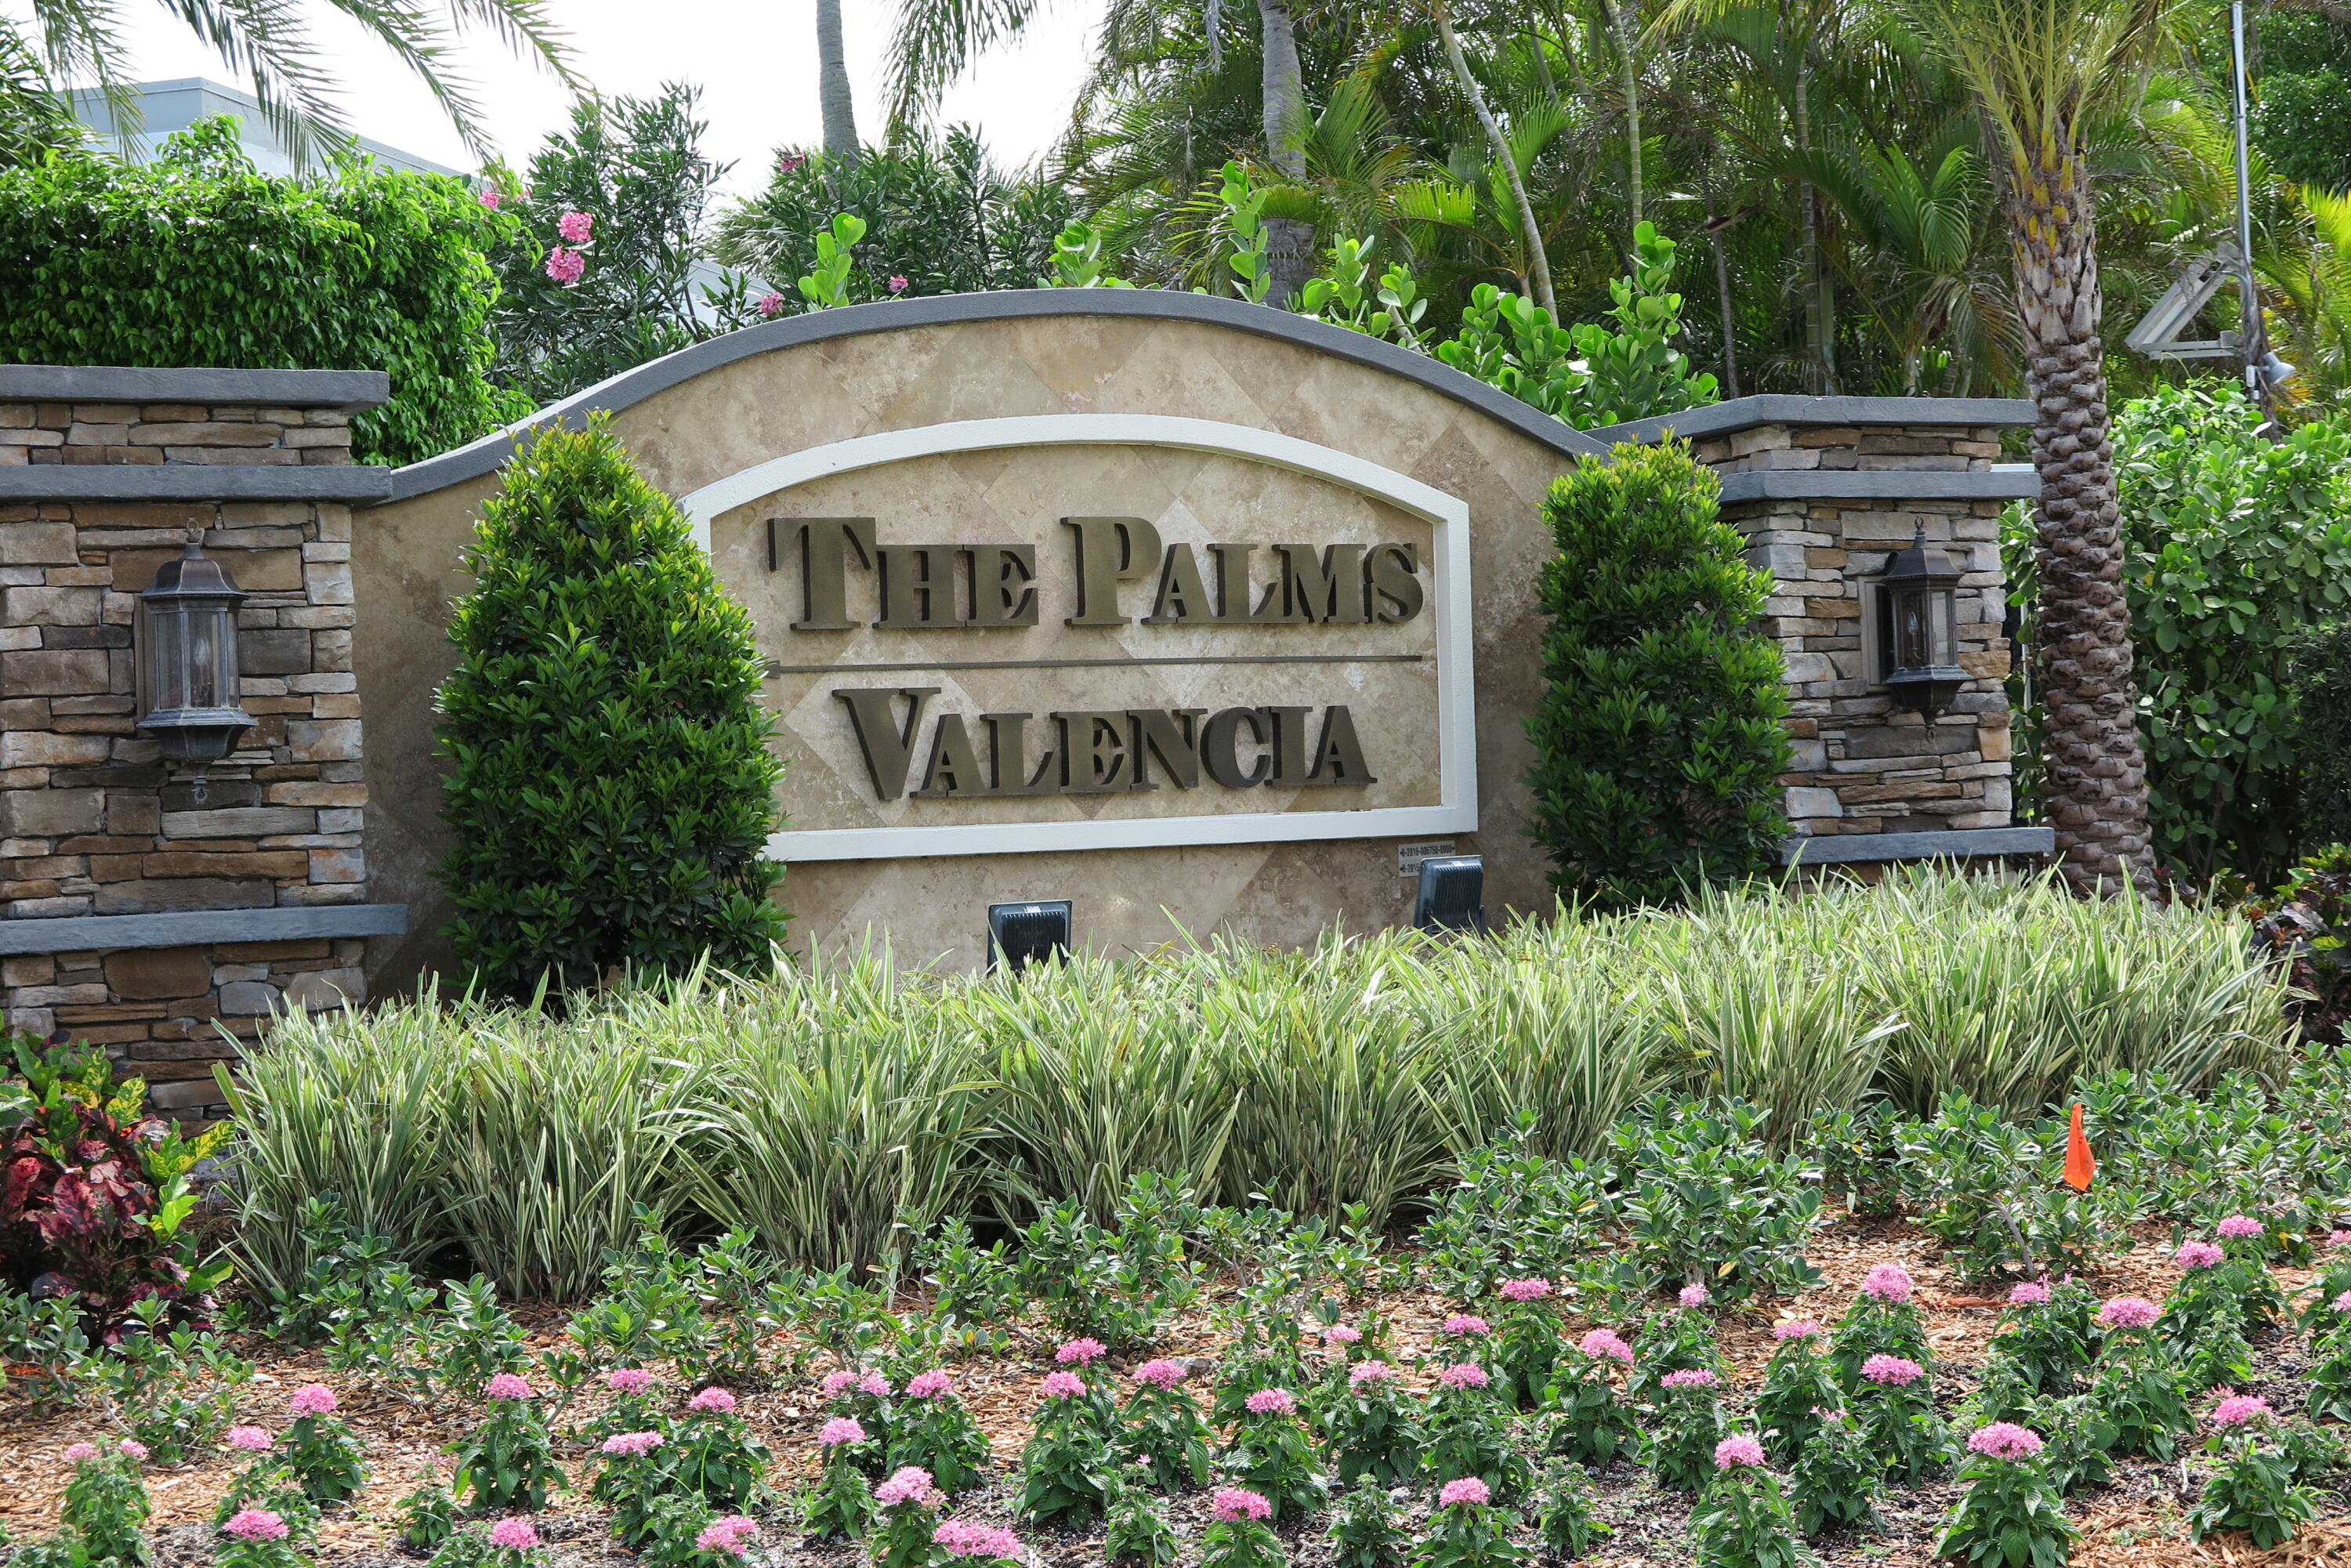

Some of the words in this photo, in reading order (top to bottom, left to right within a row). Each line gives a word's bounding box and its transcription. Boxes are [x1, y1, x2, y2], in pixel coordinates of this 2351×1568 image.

[766, 516, 1039, 630] THE
[1060, 516, 1424, 626] PALMS
[831, 686, 1378, 800] VALENCIA
